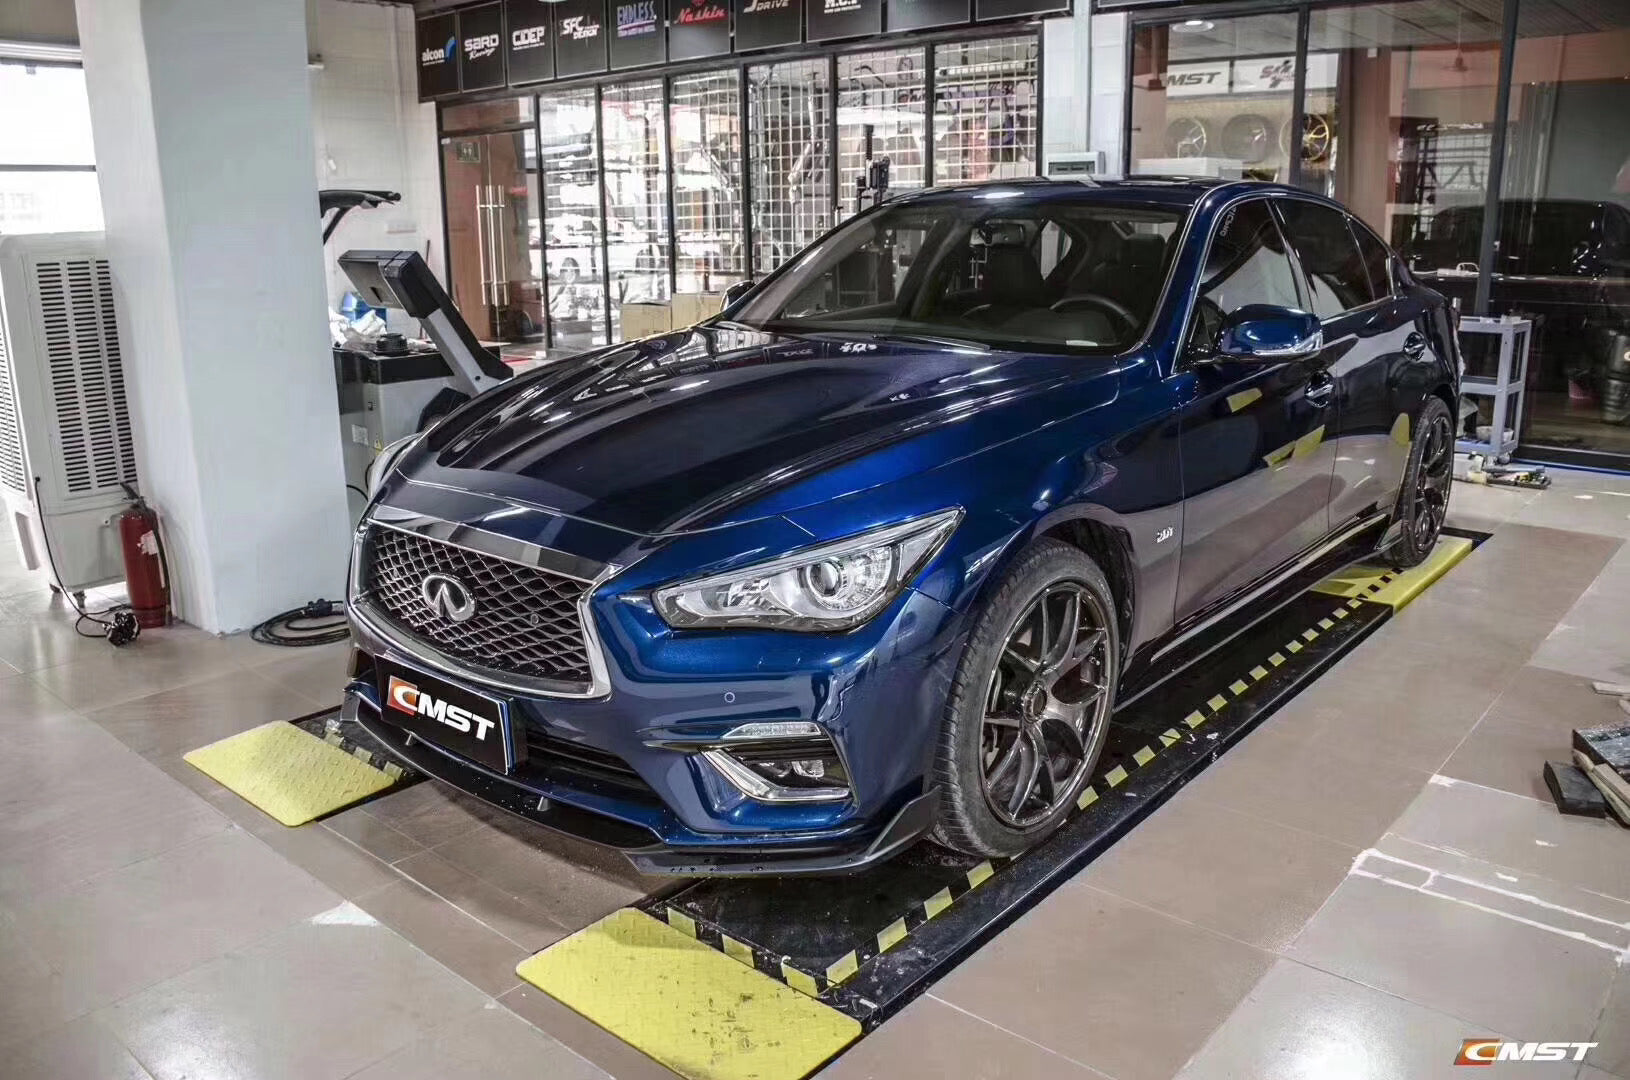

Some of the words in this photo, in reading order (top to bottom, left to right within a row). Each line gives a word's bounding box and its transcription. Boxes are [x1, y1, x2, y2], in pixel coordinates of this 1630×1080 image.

[617, 1, 655, 25] ENDLESS
[561, 16, 584, 35] SFC
[421, 48, 445, 62] alcon
[1167, 71, 1221, 86] MST
[393, 684, 495, 741] CMST
